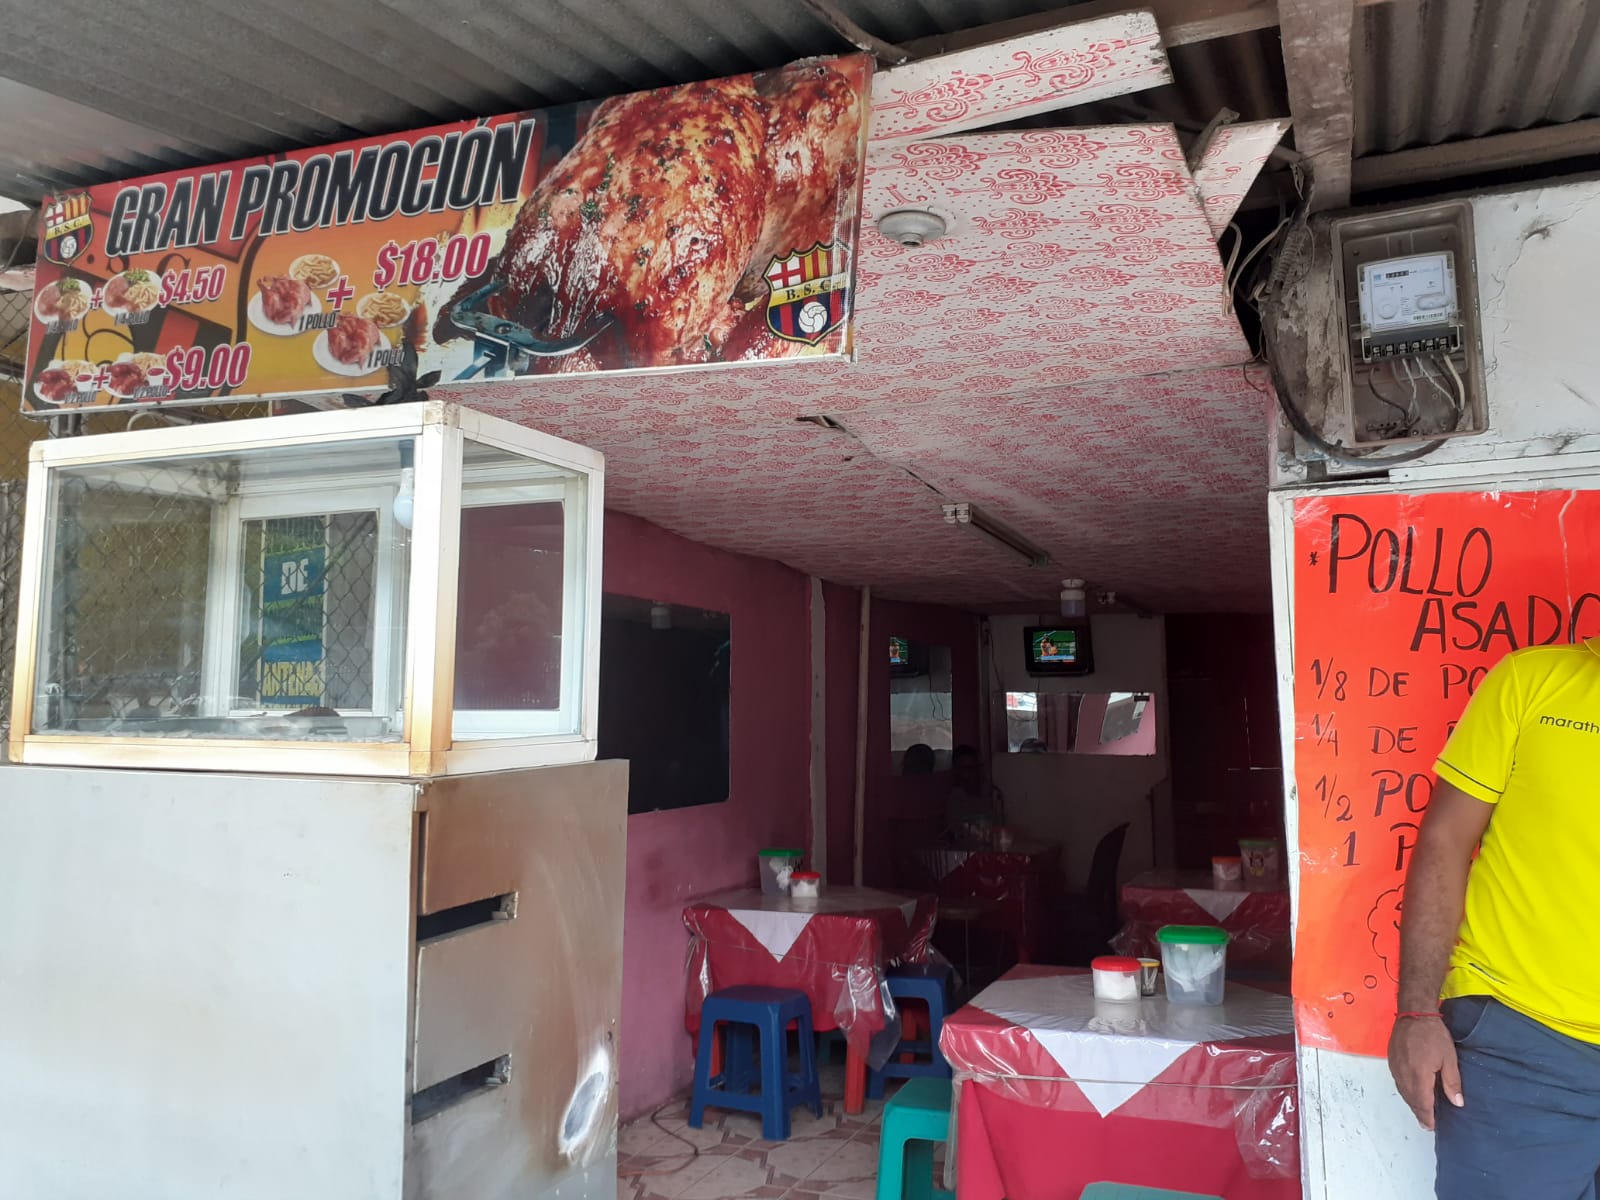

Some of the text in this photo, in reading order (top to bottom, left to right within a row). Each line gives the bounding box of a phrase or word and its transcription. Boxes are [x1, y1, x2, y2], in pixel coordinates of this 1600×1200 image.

[105, 115, 536, 257] GRAN PROMOCIÓN
[373, 232, 492, 293] $18.00
[159, 265, 227, 308] $4.50
[298, 311, 337, 331] 1 POLLO
[163, 341, 252, 396] $9.00
[367, 348, 405, 368] 1 POLLO
[281, 558, 309, 595] DE
[1329, 513, 1492, 598] POLLO
[1310, 657, 1348, 702] 1/8
[1368, 667, 1410, 698] DE
[1311, 712, 1339, 757] 1/4
[1368, 726, 1418, 755] DE
[1540, 715, 1600, 735] marath
[1315, 774, 1353, 822] 1/2
[1343, 831, 1360, 868] 1
